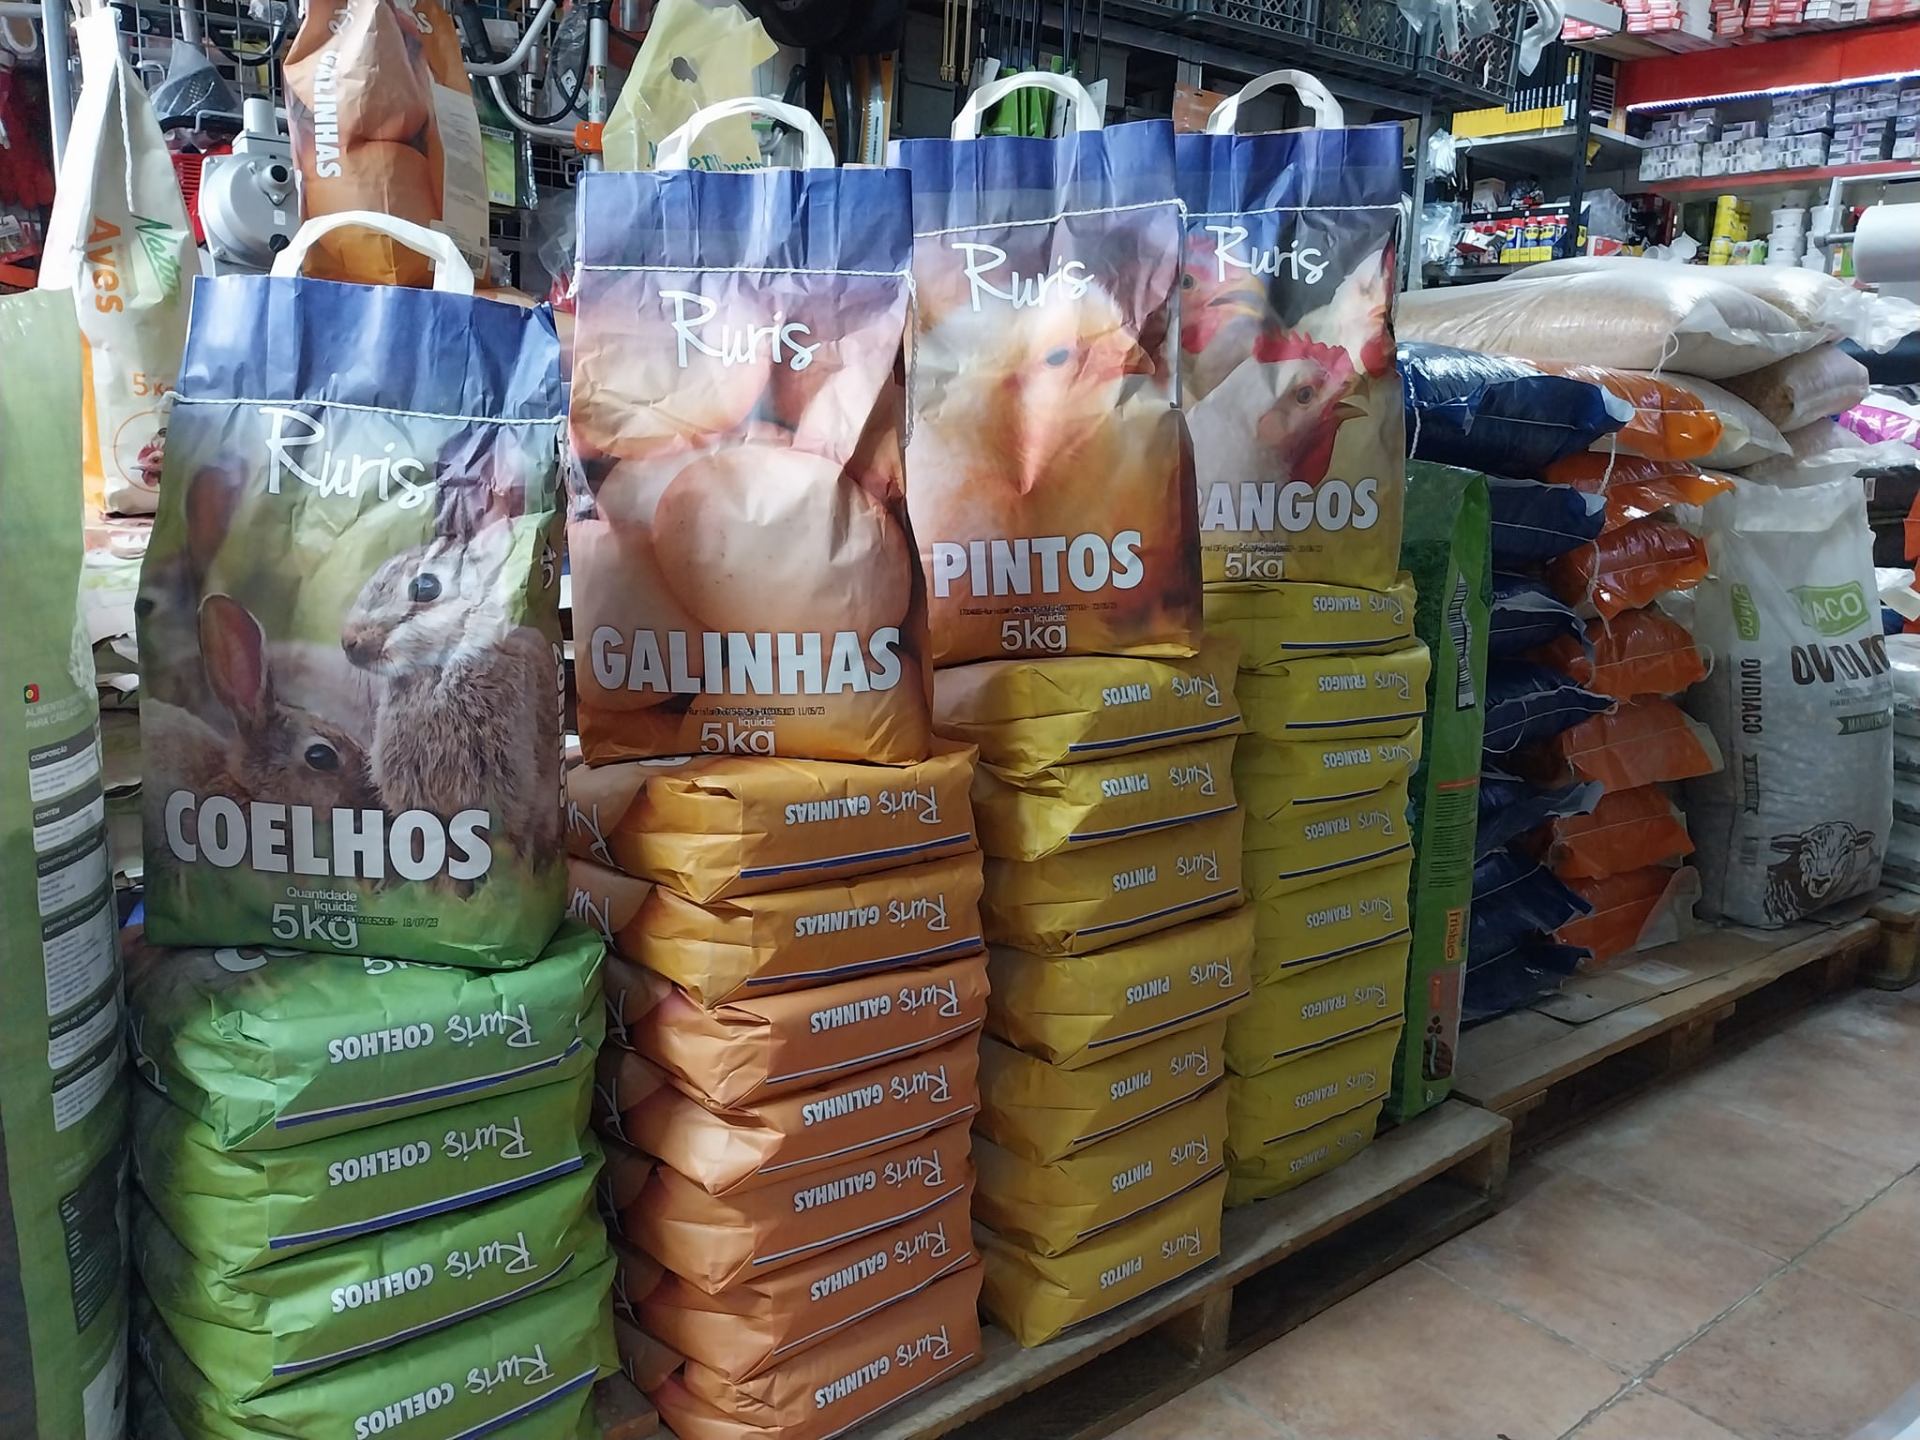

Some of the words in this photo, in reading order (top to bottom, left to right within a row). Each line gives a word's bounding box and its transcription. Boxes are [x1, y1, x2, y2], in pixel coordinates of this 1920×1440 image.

[314, 51, 343, 178] GALINHAS
[87, 216, 125, 314] Aves
[1205, 225, 1329, 285] Ruris
[951, 242, 1096, 312] Ruris
[659, 290, 822, 372] Ruris
[260, 406, 437, 509] Ruris
[1198, 478, 1379, 532] ANGOS
[931, 530, 1144, 598] PINTOS
[1224, 552, 1285, 579] 5kg
[1312, 595, 1361, 612] FRANGOS
[1001, 619, 1067, 653] 5kg
[592, 626, 901, 695] GALINHAS
[1102, 684, 1150, 706] PINTOS
[1171, 674, 1222, 707] Ruris
[1318, 673, 1367, 692] FRANGOS
[1740, 658, 1763, 734] OVIDIACO
[700, 722, 776, 757] 5kg
[1323, 750, 1371, 769] FRANGOS
[1101, 774, 1149, 797] PINTOS
[1169, 763, 1217, 796] Ruris
[784, 799, 871, 825] GALINHAS
[876, 786, 942, 825] Ruris
[164, 789, 493, 881] COELHOS
[1305, 818, 1350, 840] FRANGOS
[1112, 865, 1157, 891] PINTOS
[1176, 850, 1220, 882] Ruris
[286, 886, 358, 901] Quantidade
[271, 903, 360, 950] 5kg
[795, 911, 880, 937] GALINHAS
[886, 894, 951, 932] Ruris
[1306, 905, 1352, 929] FRANGOS
[1126, 972, 1170, 1005] PINTOS
[1190, 957, 1233, 987] Ruris
[810, 998, 892, 1034] GALINHAS
[897, 980, 962, 1017] Ruris
[1301, 996, 1348, 1020] FRANGOS
[328, 1023, 434, 1063] COELHOS
[446, 1004, 540, 1048] Ruris
[1170, 1045, 1210, 1076] Ruris
[889, 1065, 952, 1103] Ruris
[1110, 1070, 1152, 1100] PINTOS
[802, 1092, 884, 1126] GALINHAS
[442, 1117, 532, 1160] Ruris
[1170, 1134, 1209, 1165] Ruris
[328, 1141, 431, 1186] COELHOS
[882, 1150, 945, 1188] Ruris
[1111, 1161, 1153, 1193] PINTOS
[794, 1181, 876, 1212] GALINHAS
[444, 1232, 538, 1280] Ruris
[892, 1222, 950, 1263] Ruris
[1161, 1227, 1202, 1259] Ruris
[331, 1263, 434, 1312] COELHOS
[810, 1255, 887, 1301] GALINHAS
[1100, 1256, 1143, 1289] PINTOS
[895, 1325, 952, 1367] Ruris
[464, 1344, 554, 1394] Ruris
[815, 1359, 890, 1409] GALINHAS
[354, 1383, 455, 1440] COELHOS
